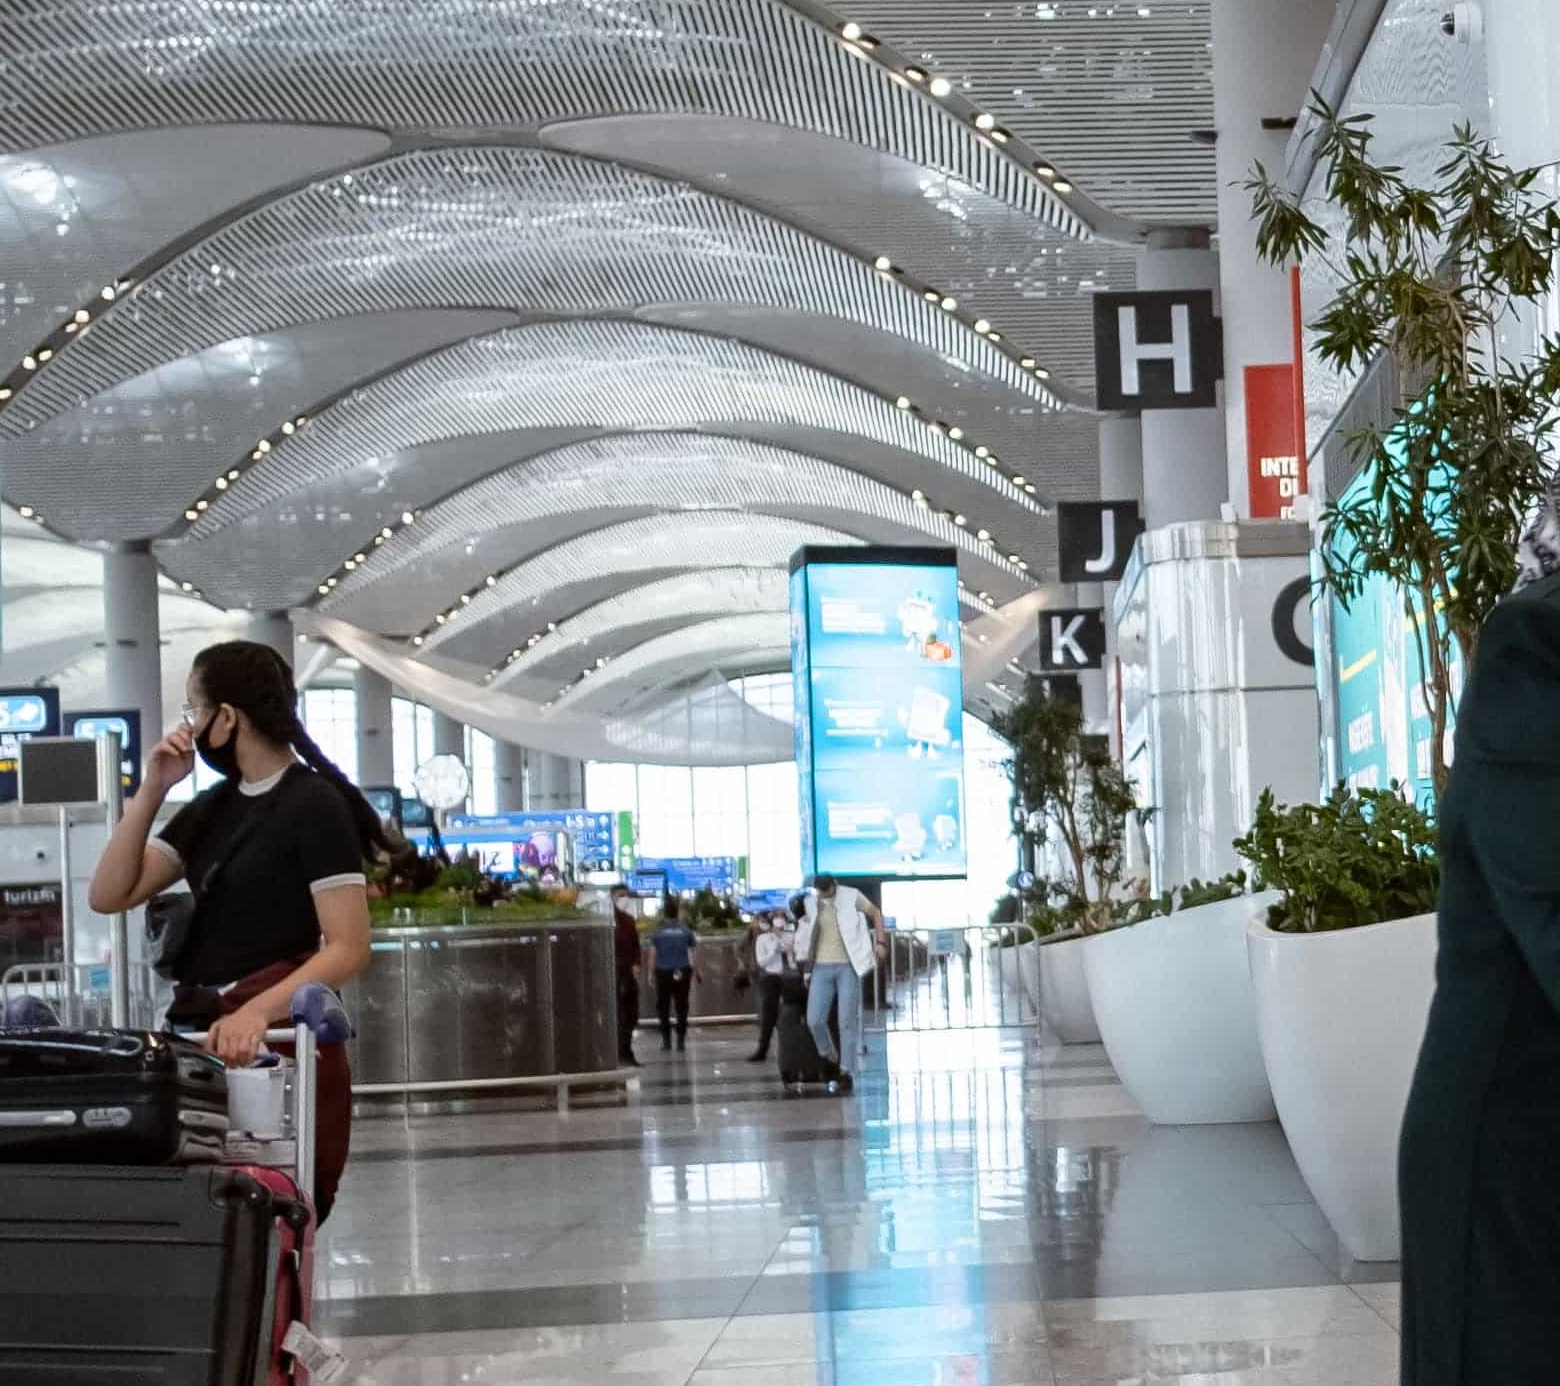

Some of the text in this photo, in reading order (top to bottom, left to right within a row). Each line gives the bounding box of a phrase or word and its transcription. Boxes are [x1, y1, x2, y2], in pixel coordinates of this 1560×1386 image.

[1117, 303, 1193, 396] H
[1084, 508, 1117, 574] J
[1050, 614, 1090, 666] K
